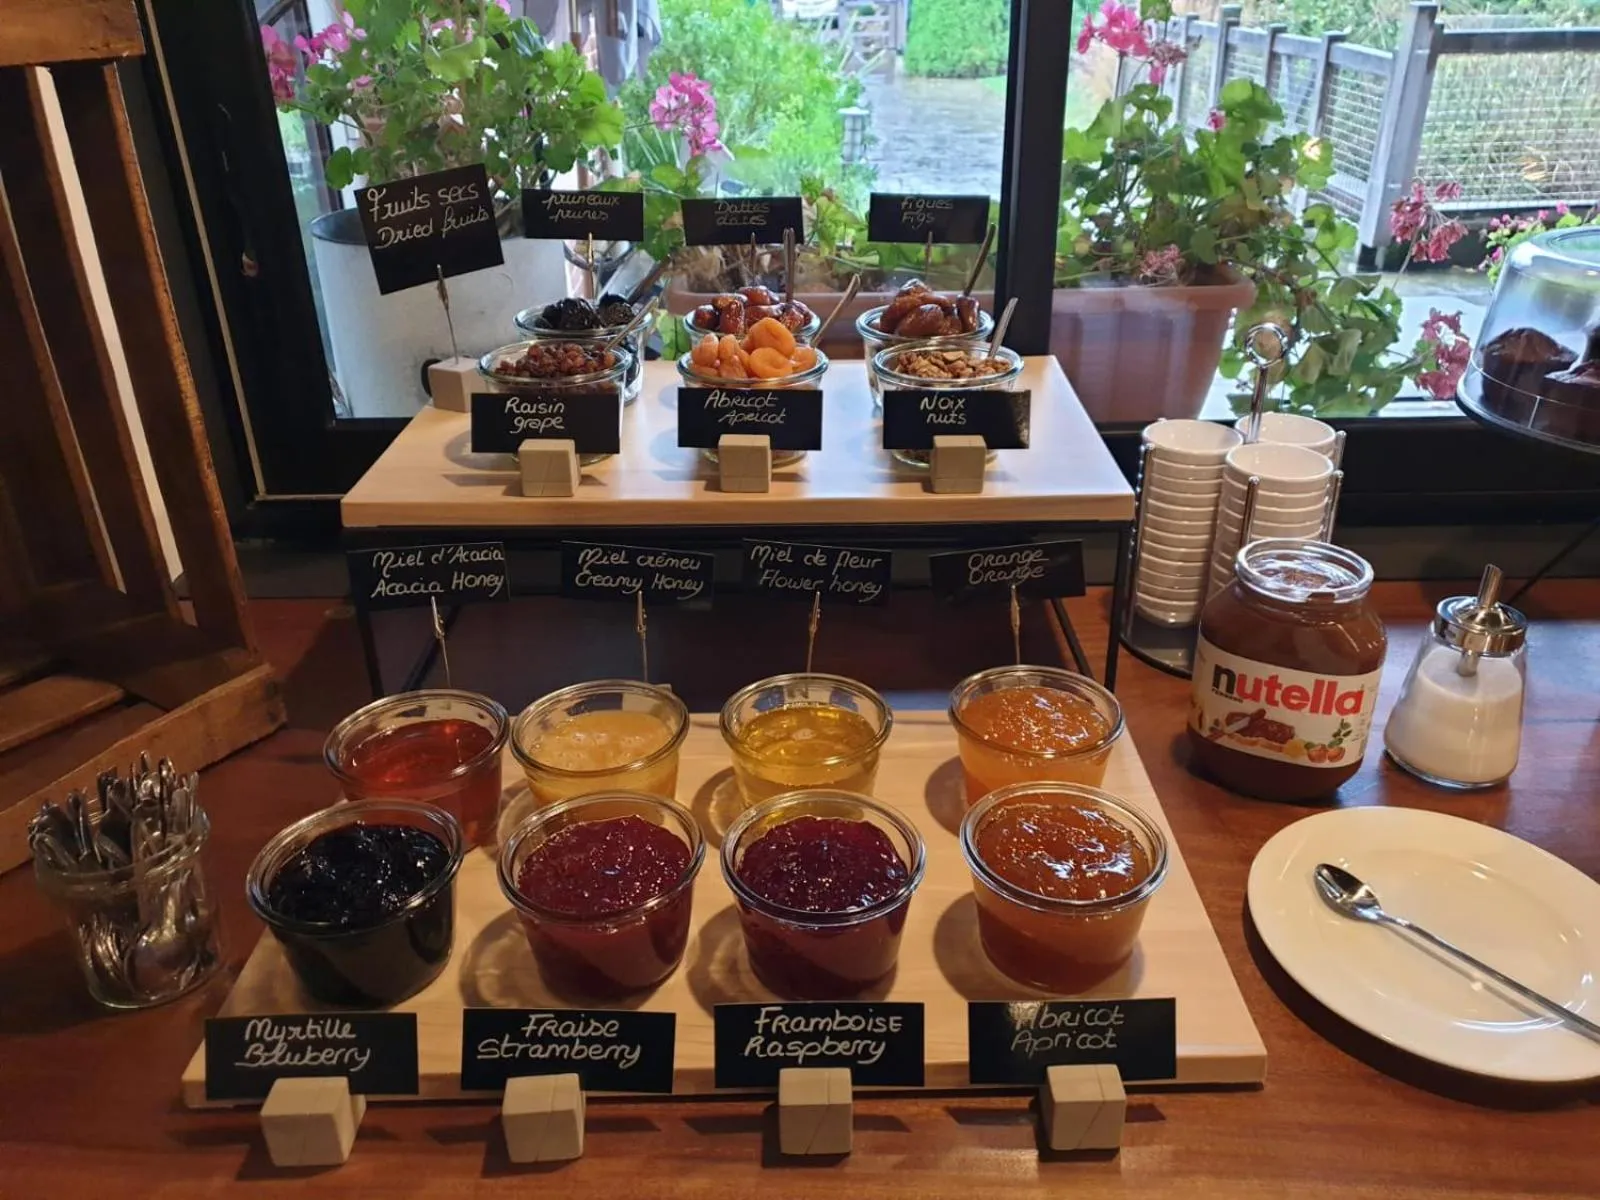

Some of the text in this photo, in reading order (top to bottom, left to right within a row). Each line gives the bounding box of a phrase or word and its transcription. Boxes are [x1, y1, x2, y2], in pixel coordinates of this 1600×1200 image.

[367, 182, 479, 223] Fruits secs
[541, 193, 620, 211] pruneaux
[714, 199, 770, 214] Dattes
[374, 204, 489, 249] Dried fruits
[549, 208, 609, 222] prunes
[716, 213, 767, 226] dates
[504, 396, 565, 414] Raisin
[703, 389, 779, 411] Abricot
[509, 416, 565, 434] grape
[718, 408, 787, 427] Apricot
[926, 411, 967, 425] nuts
[372, 550, 425, 579] Miel
[577, 547, 630, 573] Miel
[750, 545, 883, 576] Miel de fleur
[968, 549, 1050, 570] Orange
[370, 571, 505, 598] Acacia Honey
[575, 569, 704, 601] Creamy Honey
[759, 569, 883, 603] Flower honey
[968, 565, 1045, 585] Orange
[1212, 663, 1365, 717] nutella
[244, 1017, 357, 1044] Myrtille
[521, 1013, 620, 1038] Fraise
[743, 1035, 886, 1065] Raspberry
[1010, 1030, 1118, 1059] Apricot
